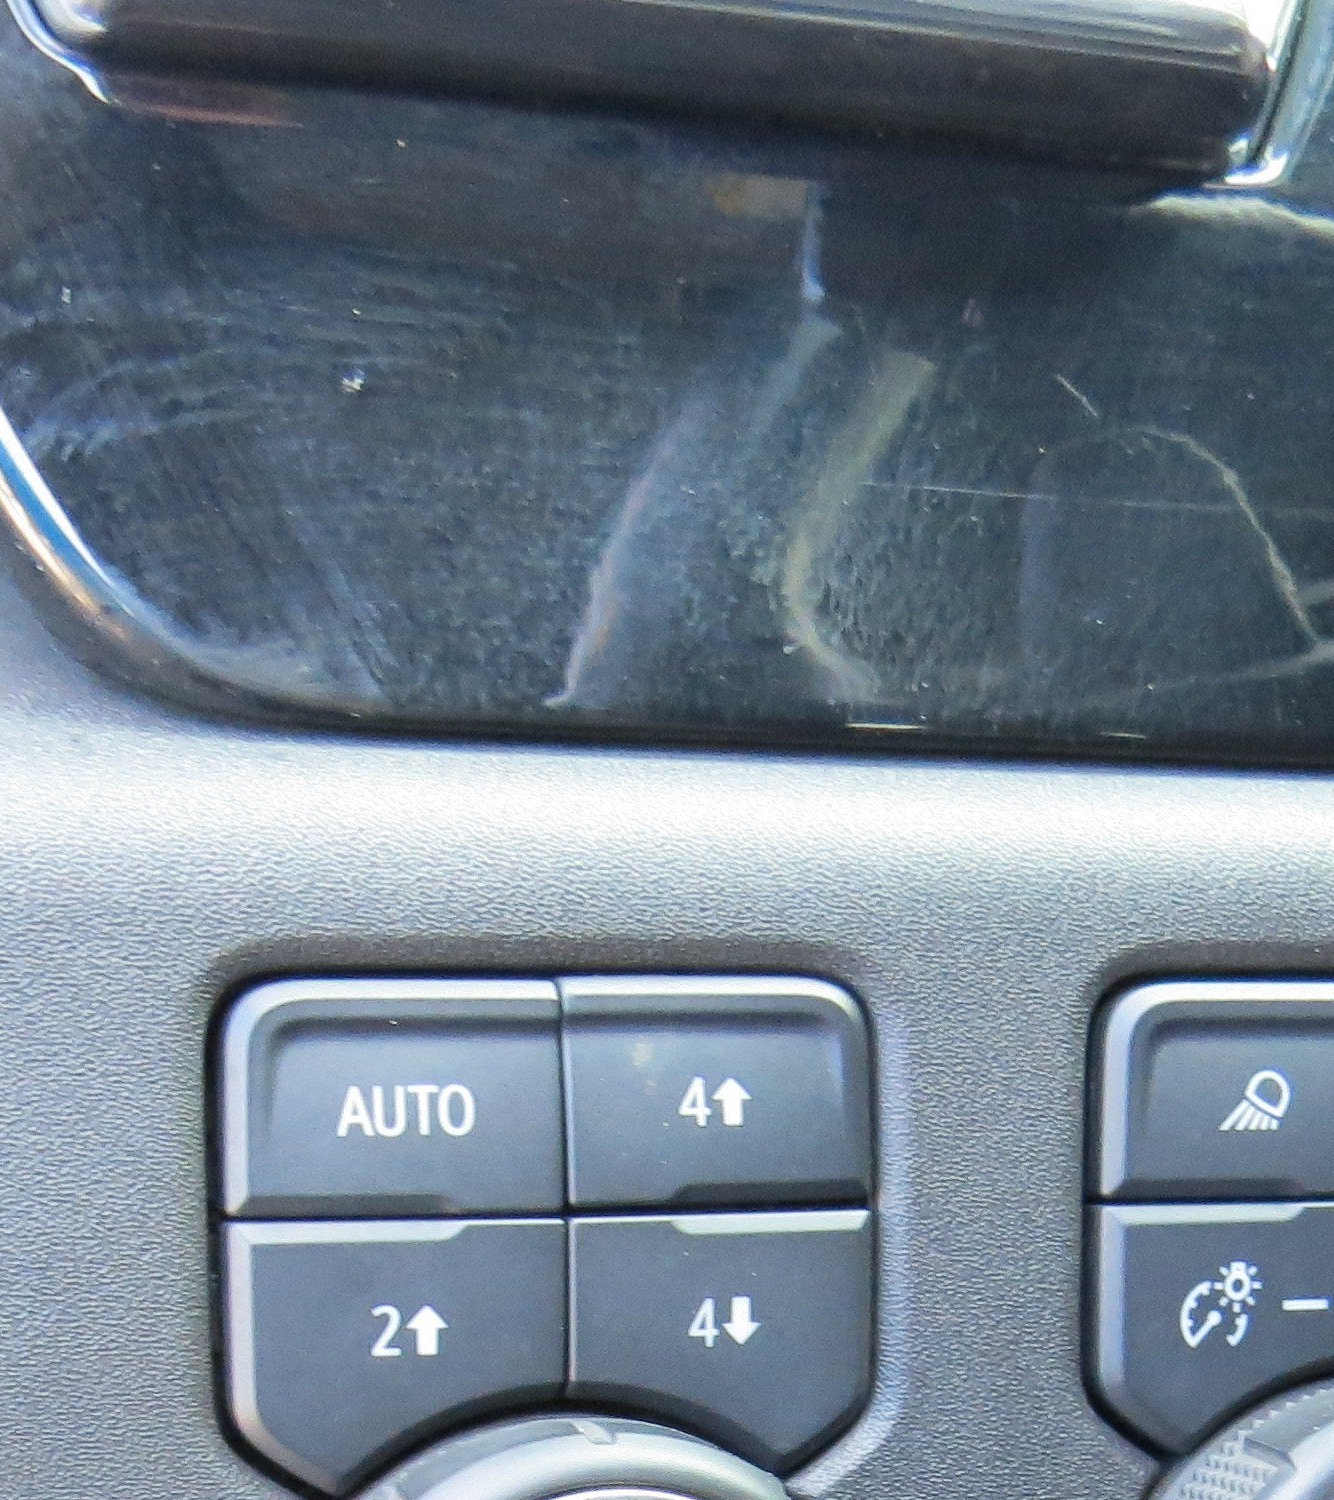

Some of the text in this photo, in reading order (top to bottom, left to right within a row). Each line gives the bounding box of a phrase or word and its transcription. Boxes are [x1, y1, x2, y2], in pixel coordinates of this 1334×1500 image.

[336, 1083, 477, 1139] AUTO
[677, 1075, 712, 1128] 4
[370, 1305, 403, 1358] 2
[687, 1297, 720, 1349] 4
